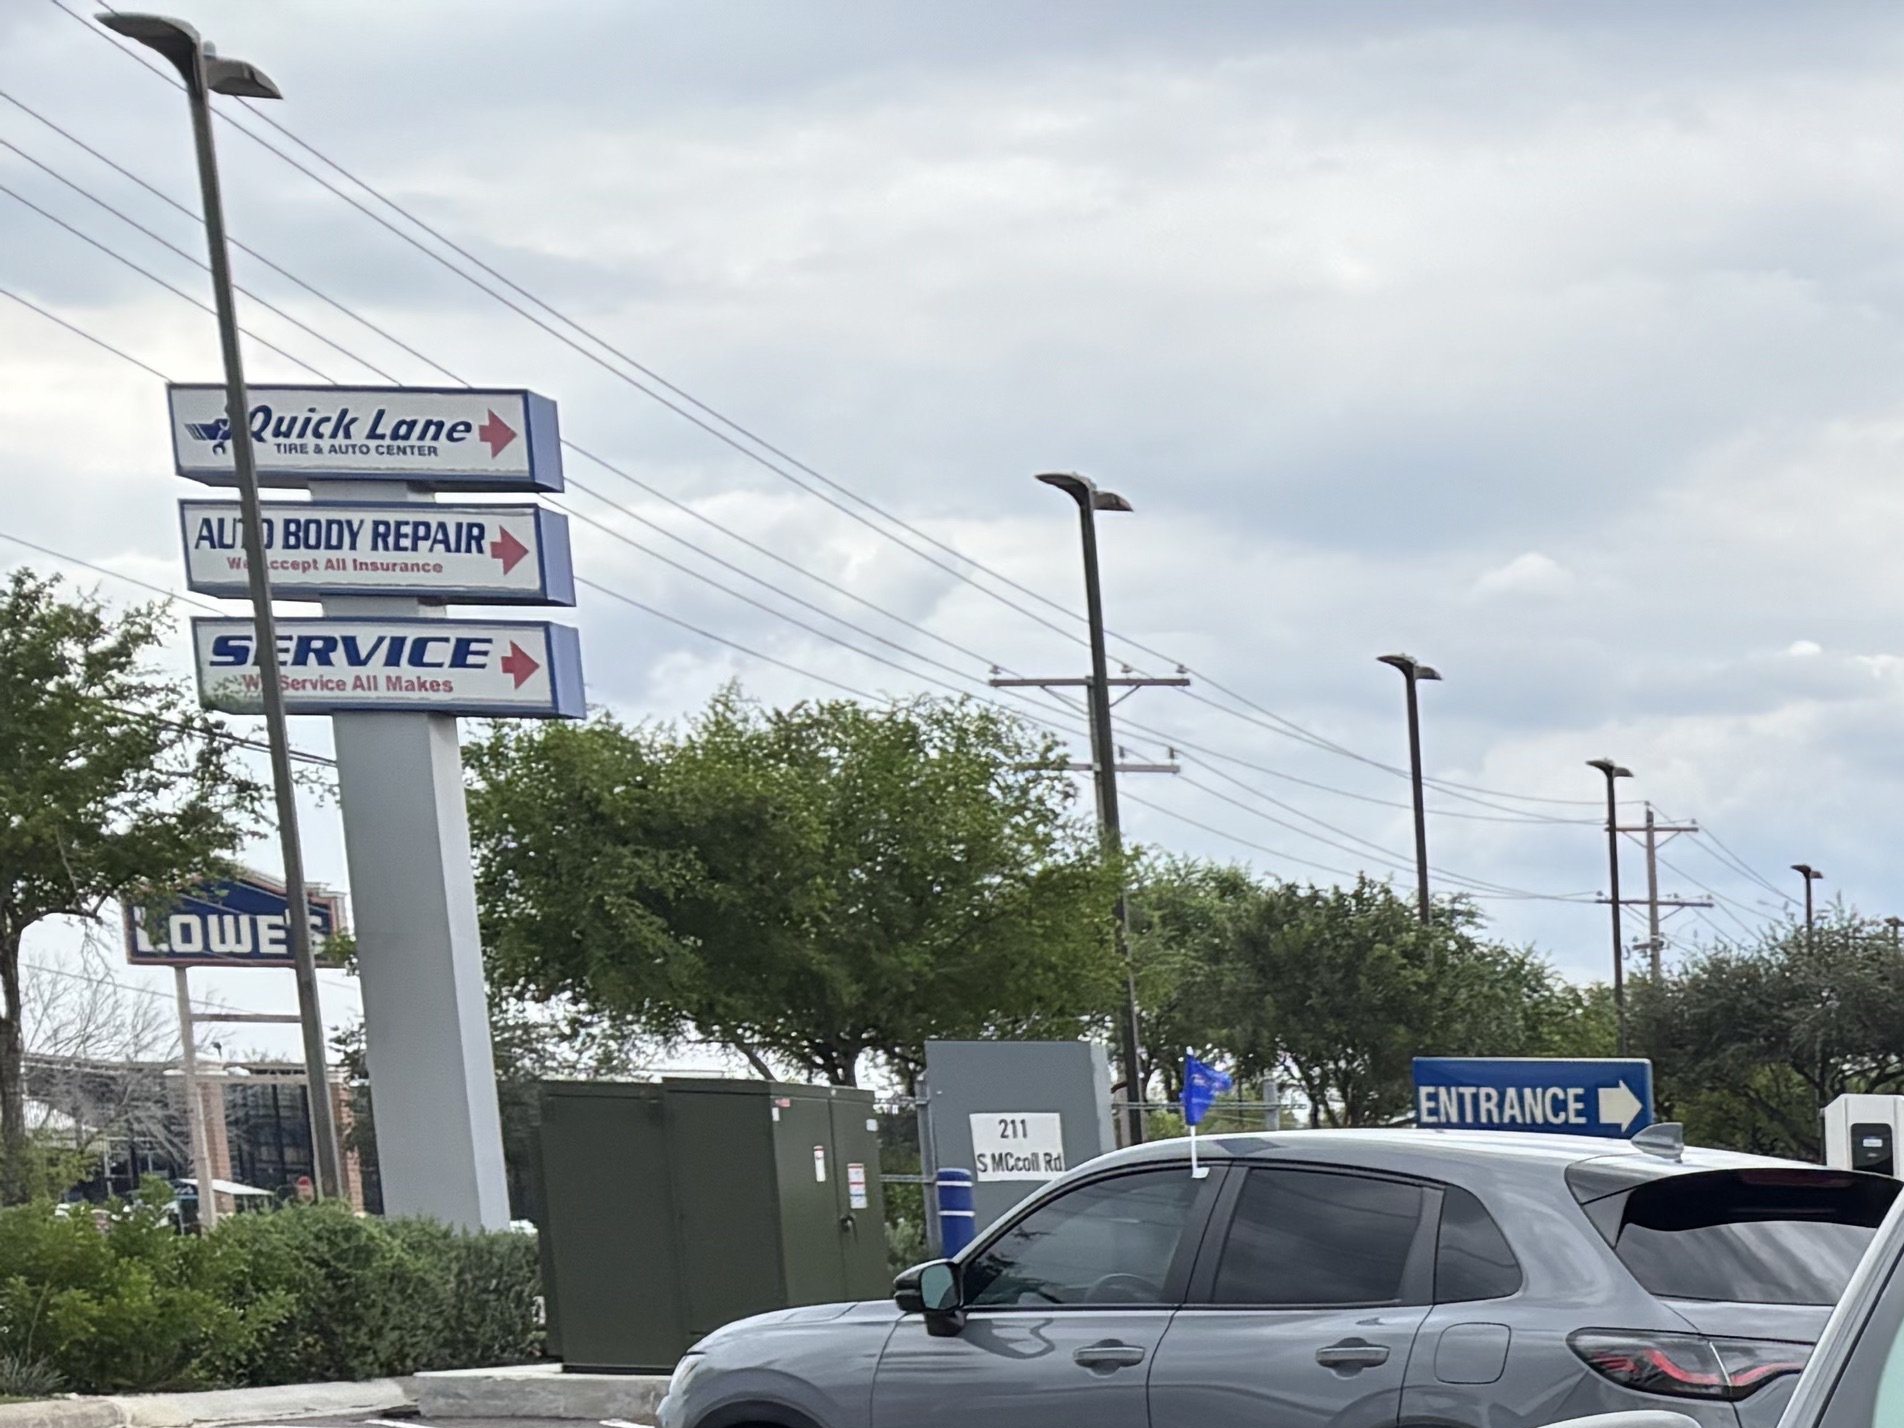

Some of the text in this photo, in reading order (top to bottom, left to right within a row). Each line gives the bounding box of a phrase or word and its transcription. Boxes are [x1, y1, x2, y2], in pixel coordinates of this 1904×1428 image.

[249, 405, 473, 443] Quick Lane
[274, 443, 439, 457] TIRE & AUTO CENTER
[282, 518, 365, 551] BODY
[371, 519, 485, 554] REPAIR
[264, 557, 319, 573] ccept
[324, 557, 347, 571] All
[352, 558, 443, 574] Insurance
[279, 674, 347, 692] Service
[352, 674, 378, 692] All
[385, 675, 454, 693] Makes
[1418, 1086, 1587, 1125] ENTRANCE
[998, 1118, 1028, 1139] 211
[976, 1153, 988, 1173] S
[1043, 1152, 1063, 1172] Rd
